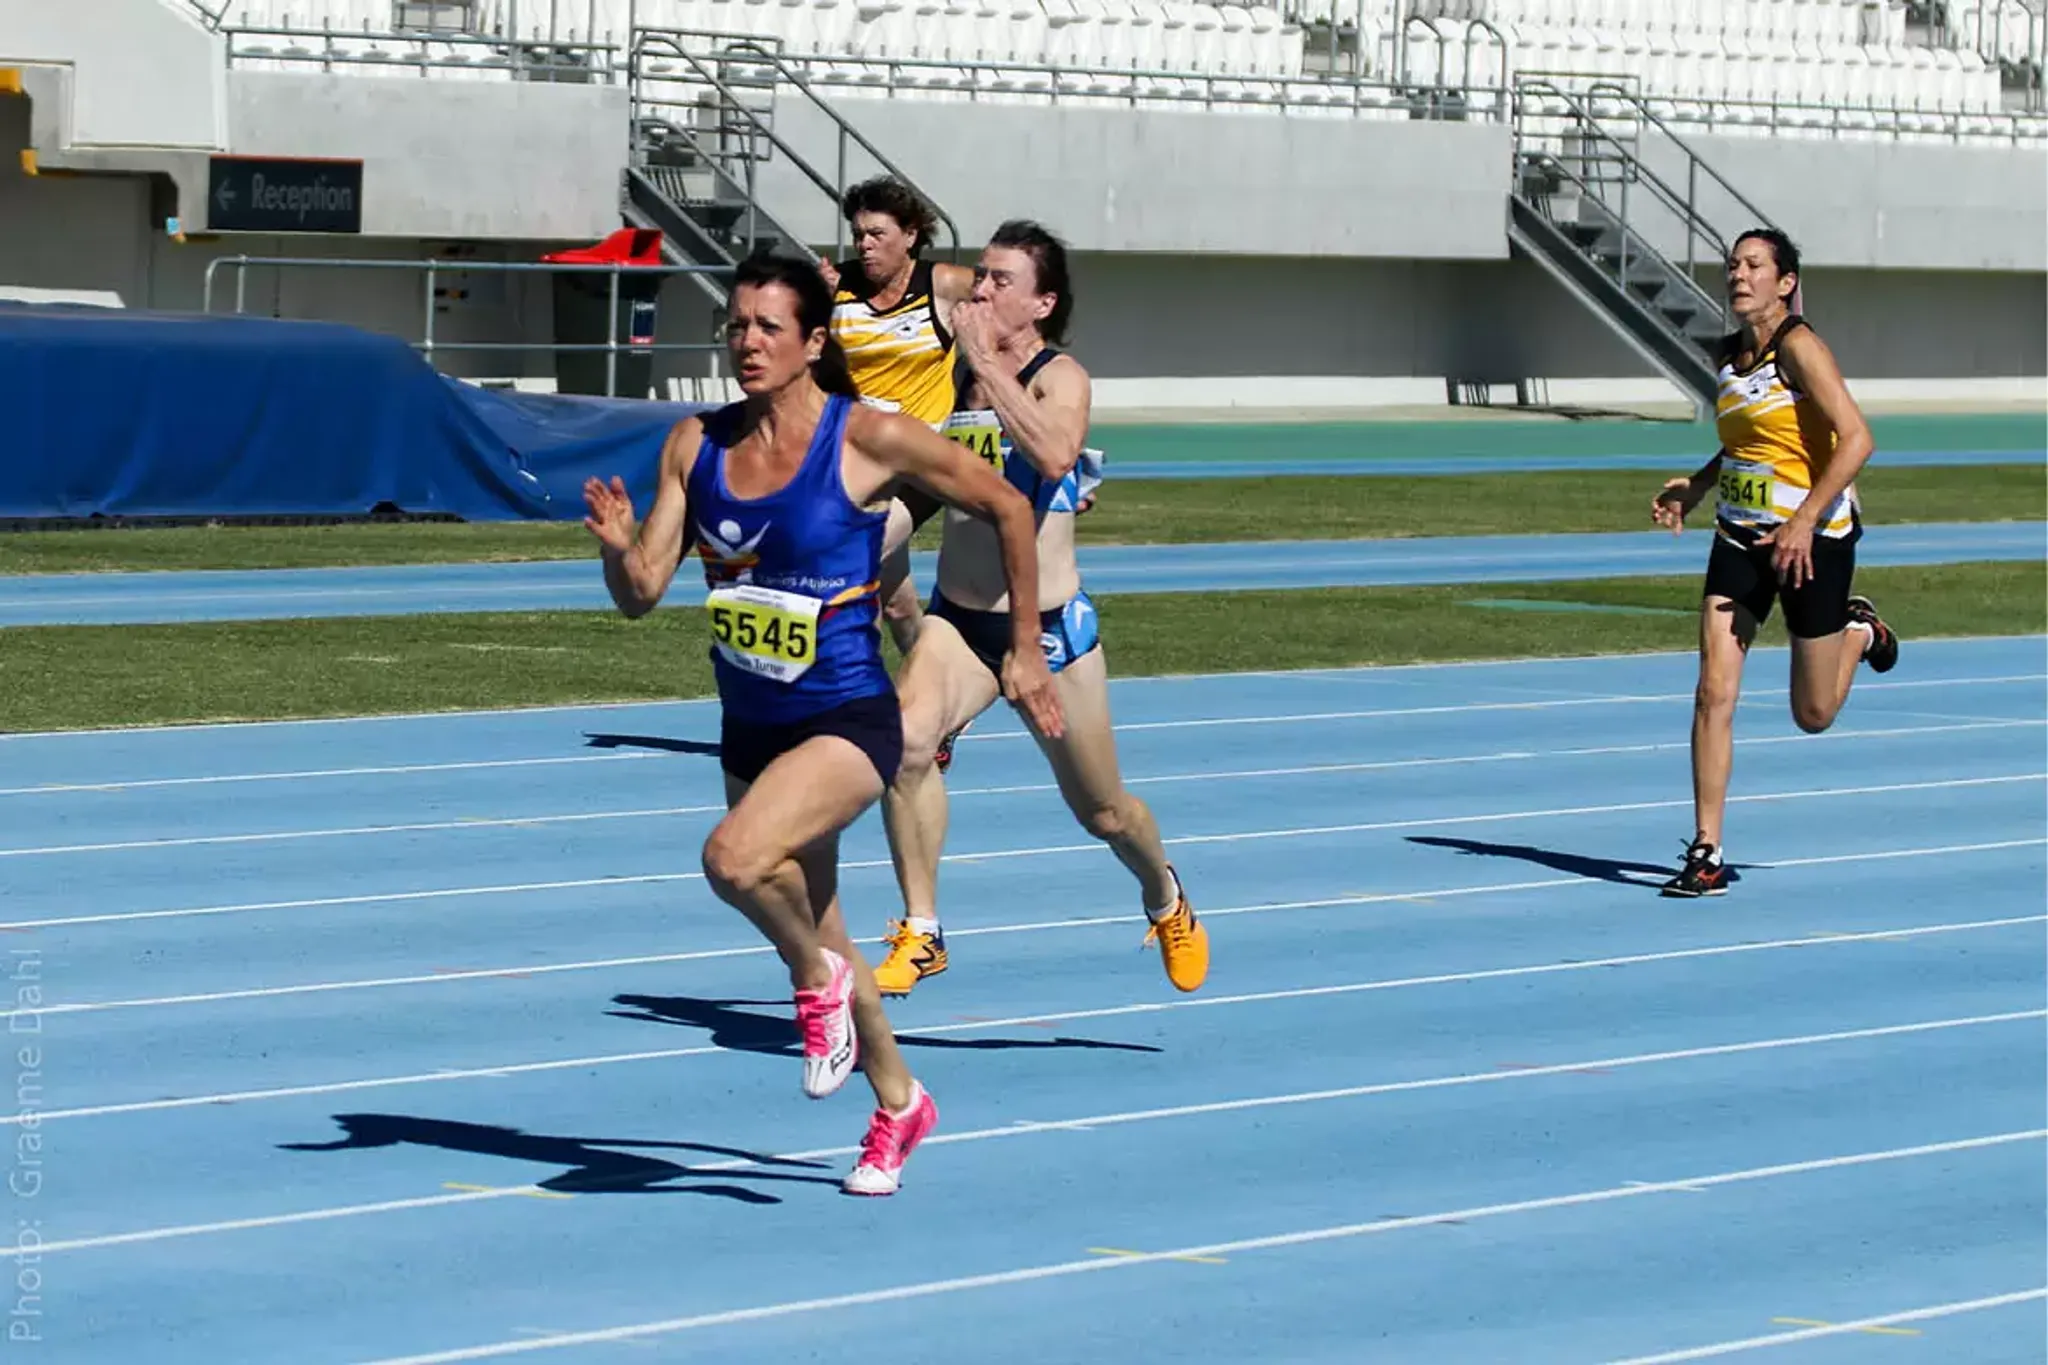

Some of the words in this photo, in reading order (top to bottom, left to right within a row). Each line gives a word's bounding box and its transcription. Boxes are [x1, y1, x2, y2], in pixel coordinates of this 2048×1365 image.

[252, 172, 353, 224] Reception
[1720, 475, 1767, 507] 5541
[712, 607, 809, 659] 5545
